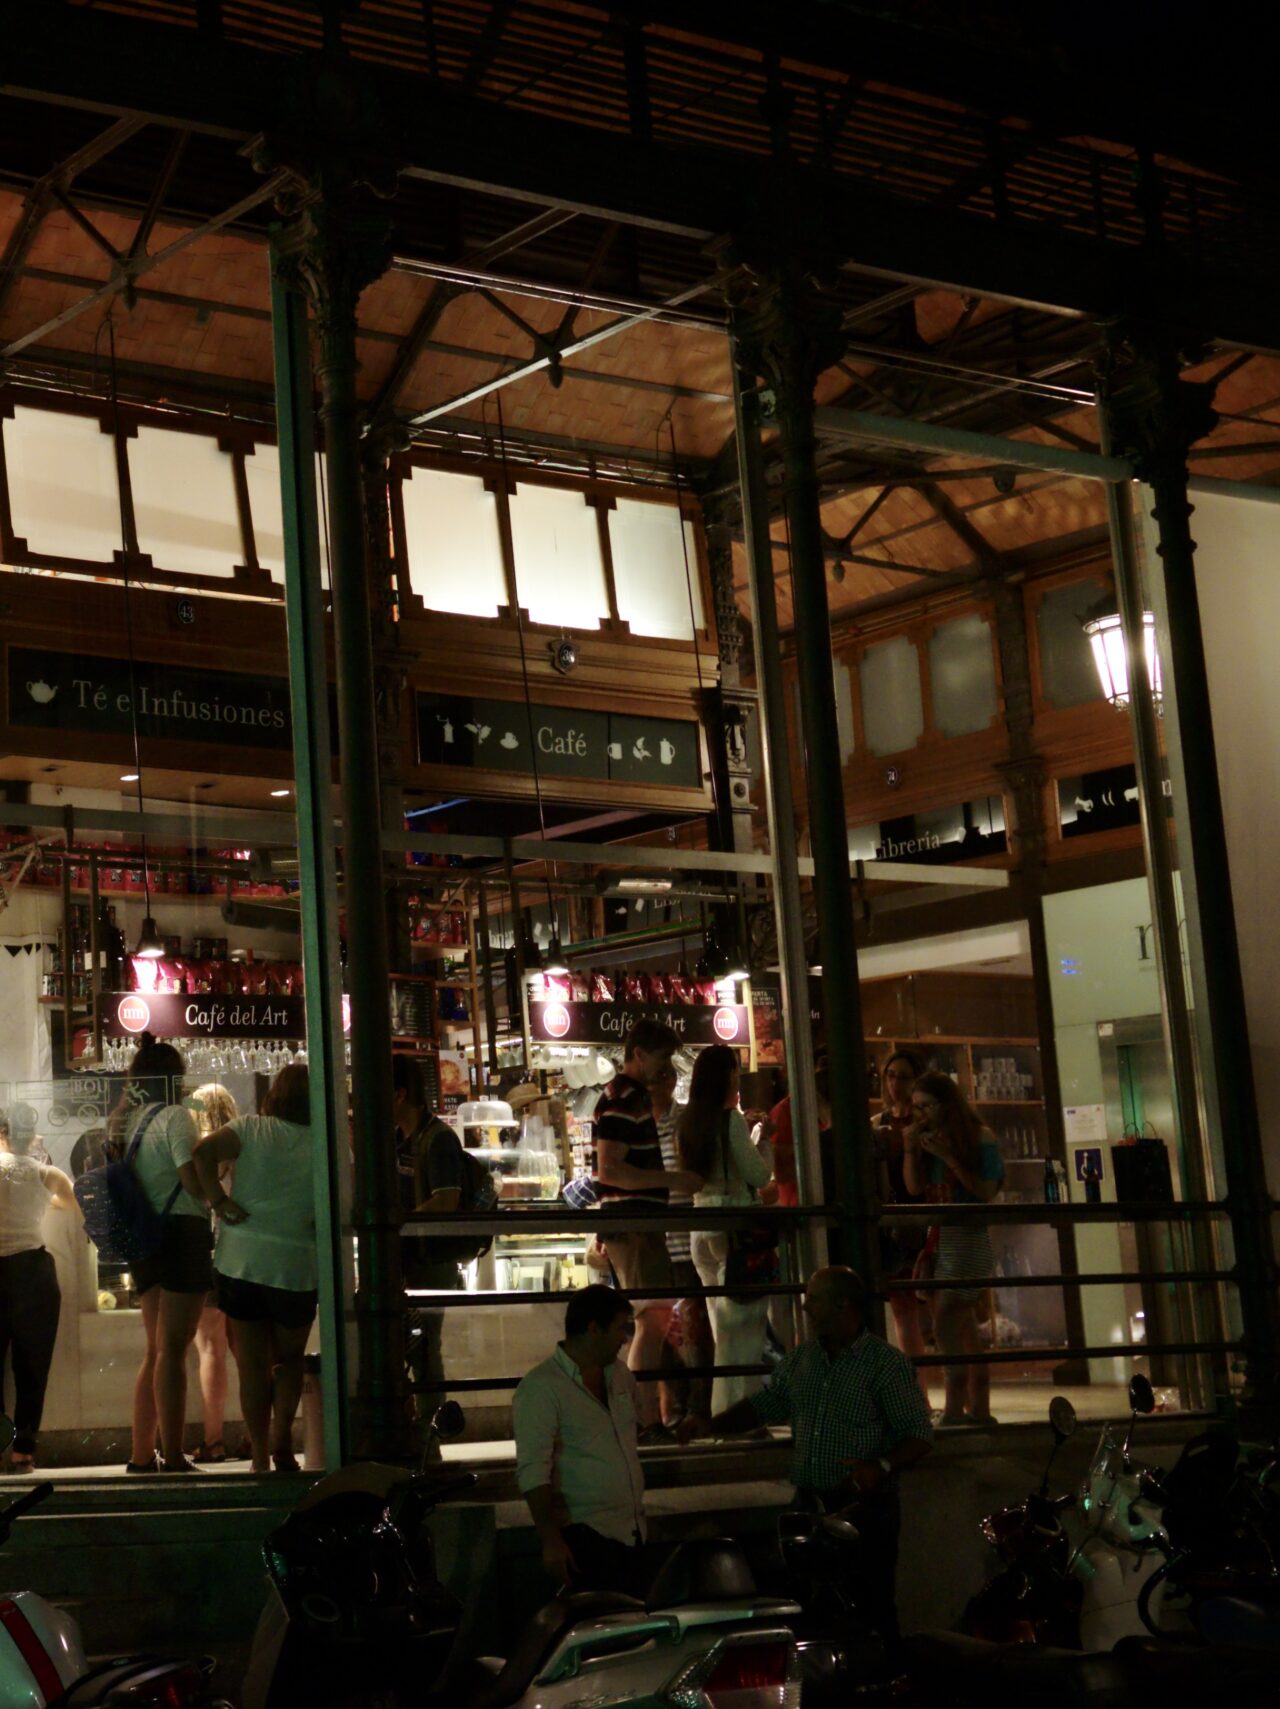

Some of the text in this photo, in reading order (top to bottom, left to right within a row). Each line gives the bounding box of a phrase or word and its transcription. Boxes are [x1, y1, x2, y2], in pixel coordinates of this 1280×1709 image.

[72, 679, 287, 729] Té e Infusiones
[537, 726, 588, 757] Café
[185, 1003, 289, 1032] Café del Art
[599, 1011, 634, 1037] Café
[664, 1013, 686, 1032] Art
